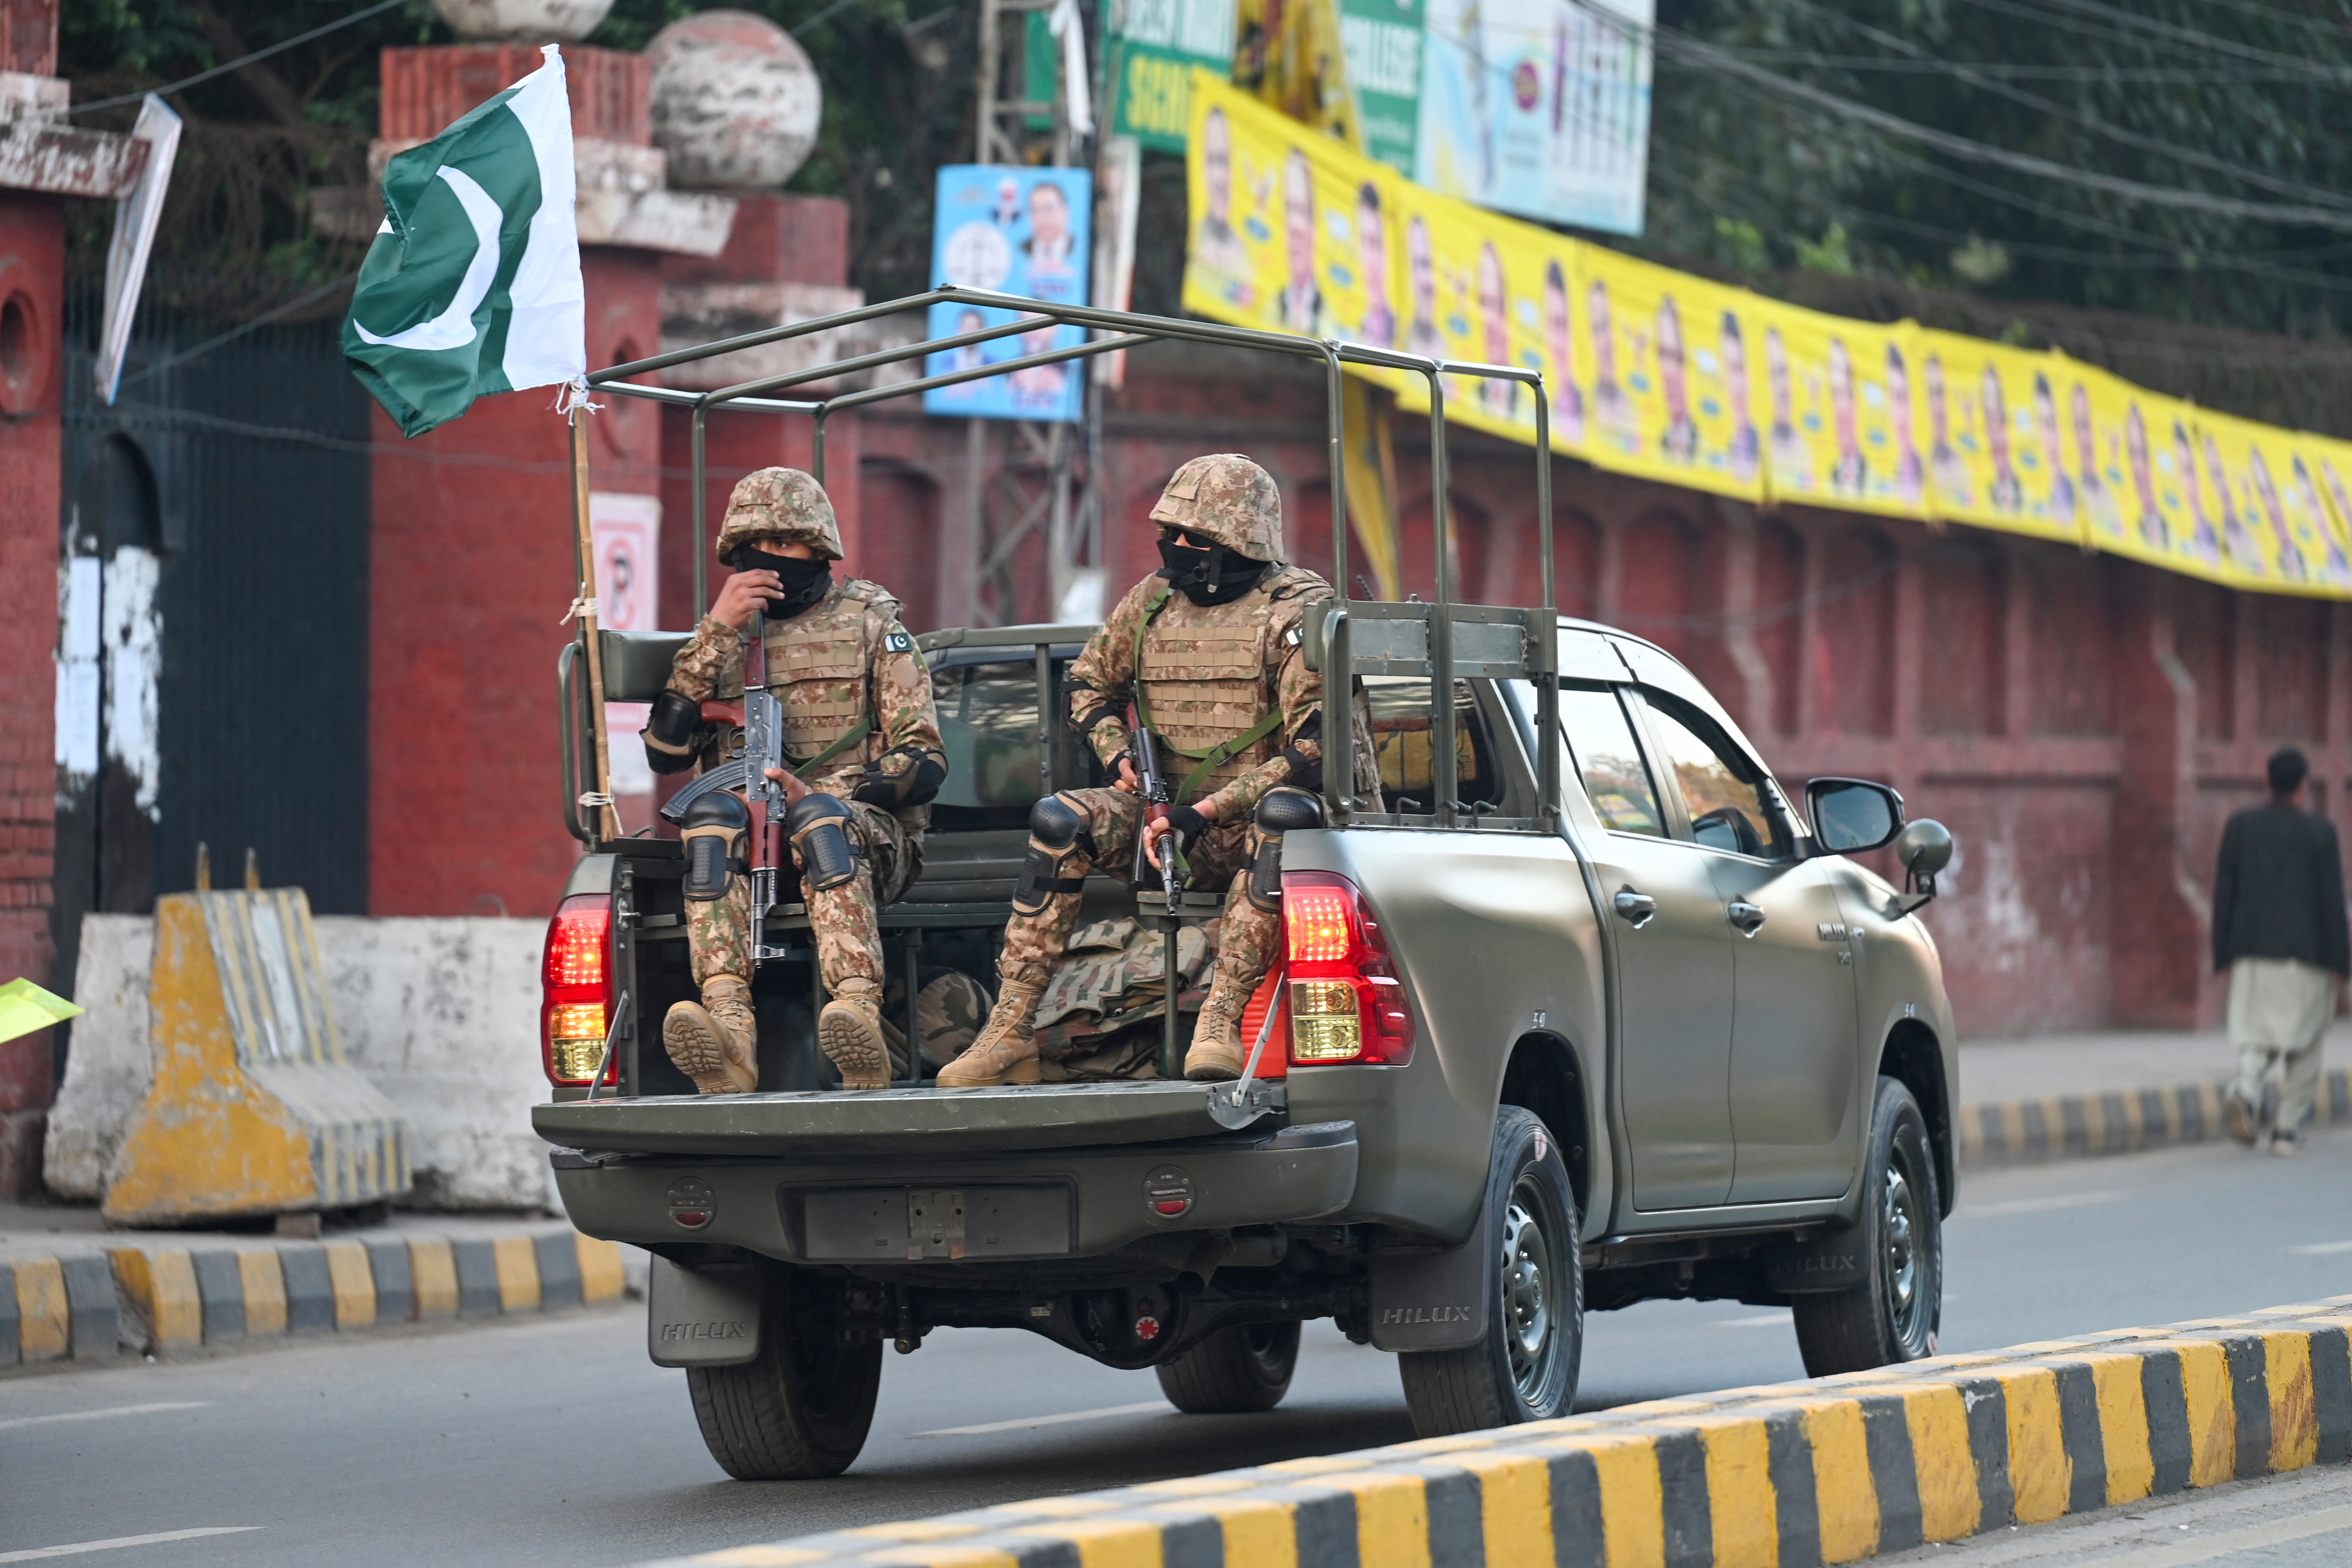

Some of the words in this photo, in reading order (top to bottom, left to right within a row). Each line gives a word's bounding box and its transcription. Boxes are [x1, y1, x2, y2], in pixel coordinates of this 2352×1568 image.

[1566, 1208, 1581, 1334] DUNLOP
[1382, 1304, 1473, 1325] HILUX
[661, 1321, 747, 1341] HILUX
